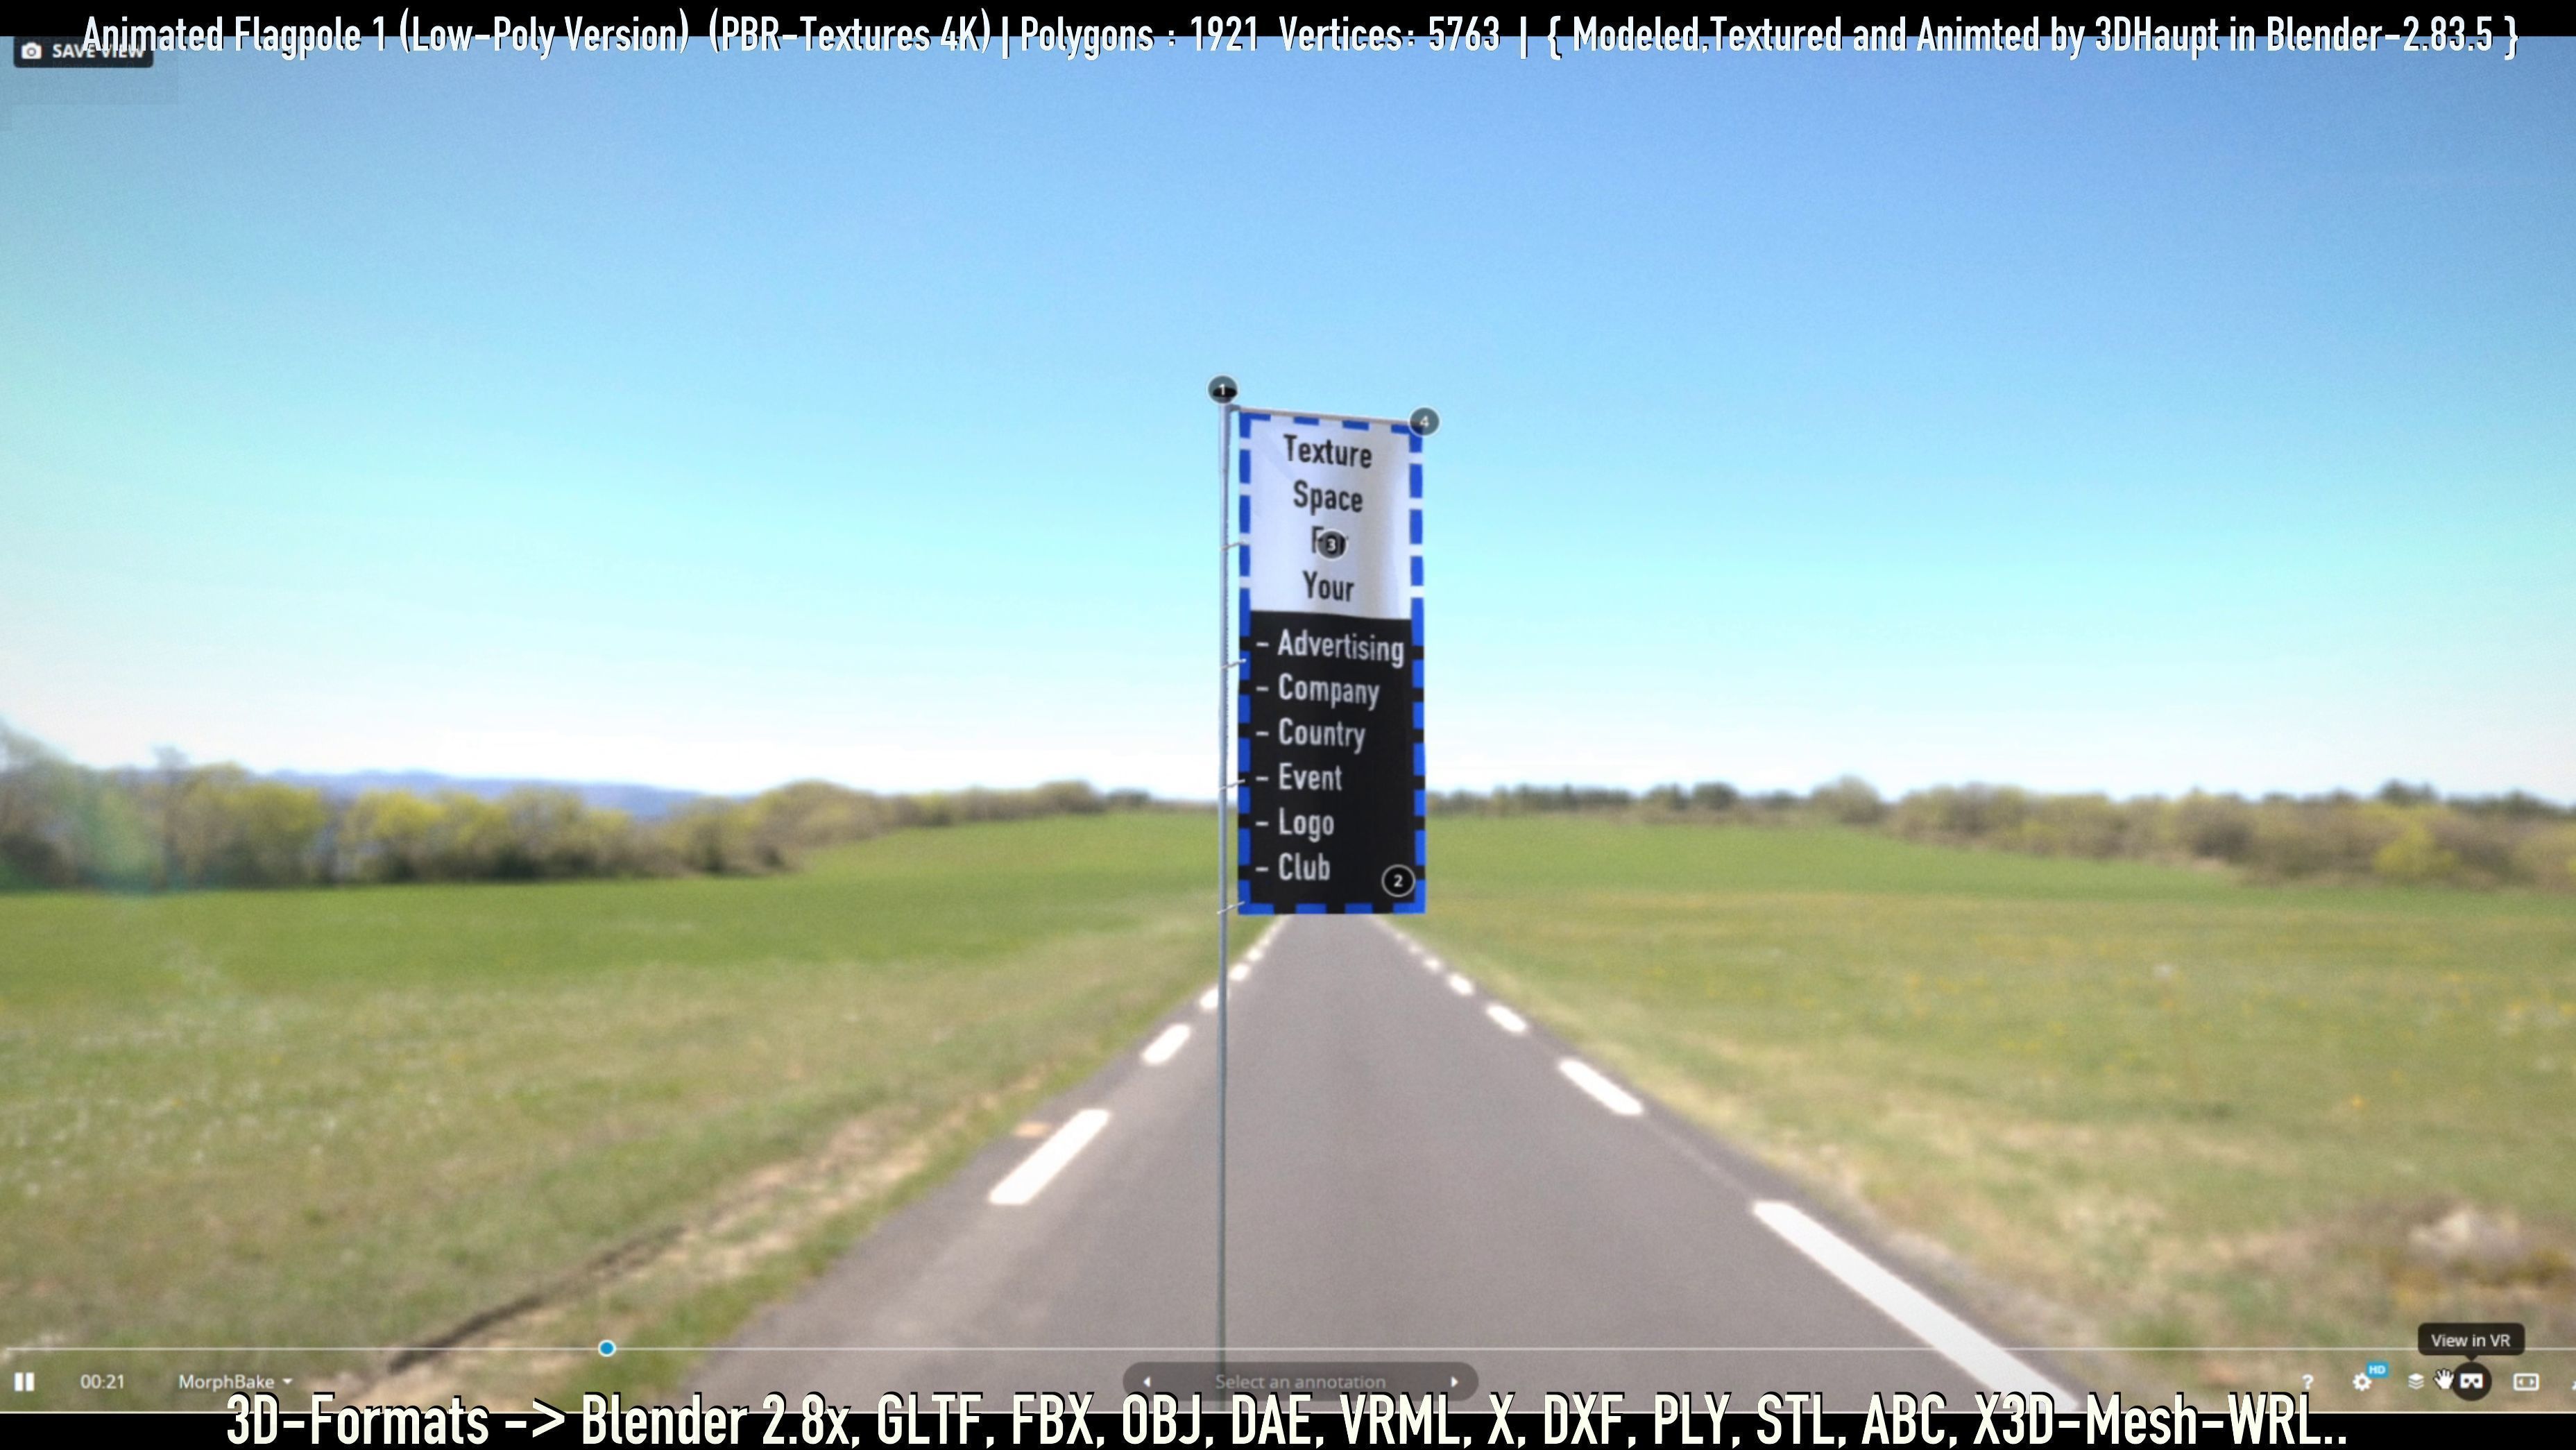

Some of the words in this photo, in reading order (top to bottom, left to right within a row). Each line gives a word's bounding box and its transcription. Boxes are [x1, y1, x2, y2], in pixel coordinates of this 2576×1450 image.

[53, 44, 95, 59] SAVE
[1420, 416, 1430, 427] 4
[1283, 434, 1372, 470] Texture
[1293, 479, 1363, 516] Space
[1302, 570, 1355, 602] Your
[1277, 629, 1405, 669] Advertising
[1279, 672, 1380, 712] Company
[1279, 717, 1366, 755] Country
[1279, 762, 1342, 791] Event
[1279, 807, 1335, 843] Logo
[1279, 852, 1331, 881] Club
[1393, 874, 1404, 887] 2
[2431, 1333, 2468, 1347] View
[2473, 1333, 2486, 1347] in
[2489, 1334, 2511, 1347] VR
[80, 1374, 125, 1389] 00:21
[179, 1374, 275, 1392] MorphBake
[1216, 1374, 1265, 1390] Select
[1270, 1377, 1290, 1389] an
[1295, 1374, 1387, 1390] annotation
[2369, 1365, 2386, 1375] HD
